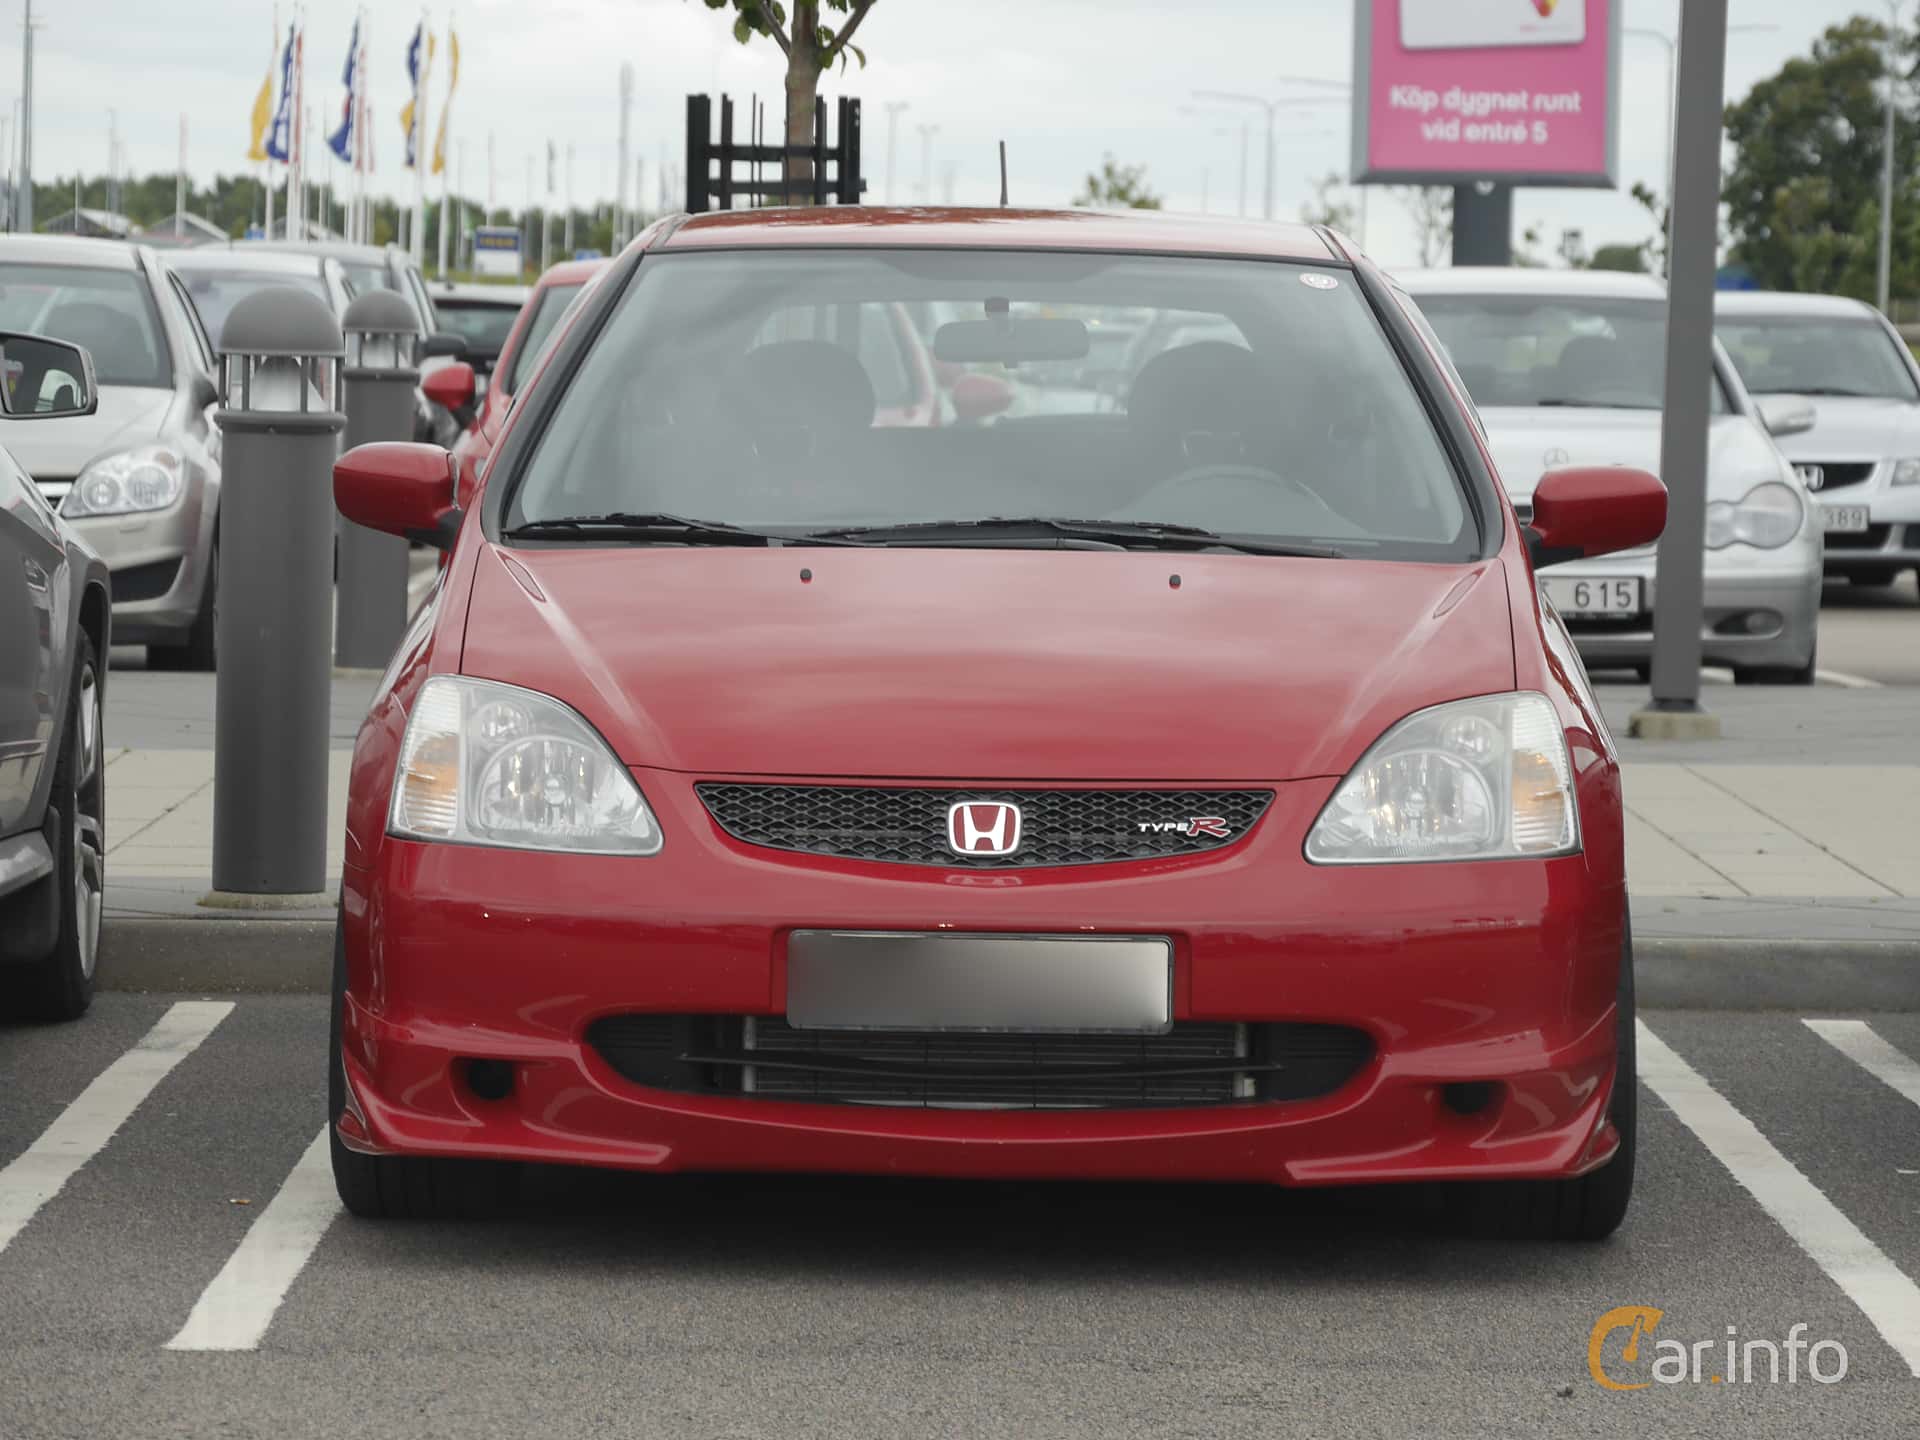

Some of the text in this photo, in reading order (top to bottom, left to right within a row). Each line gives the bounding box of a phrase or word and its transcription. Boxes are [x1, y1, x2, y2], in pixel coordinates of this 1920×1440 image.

[1390, 85, 1581, 117] Köp dygnet runt
[1421, 118, 1548, 144] vid entré 5
[1575, 582, 1631, 608] 615
[1138, 822, 1188, 832] TYPE
